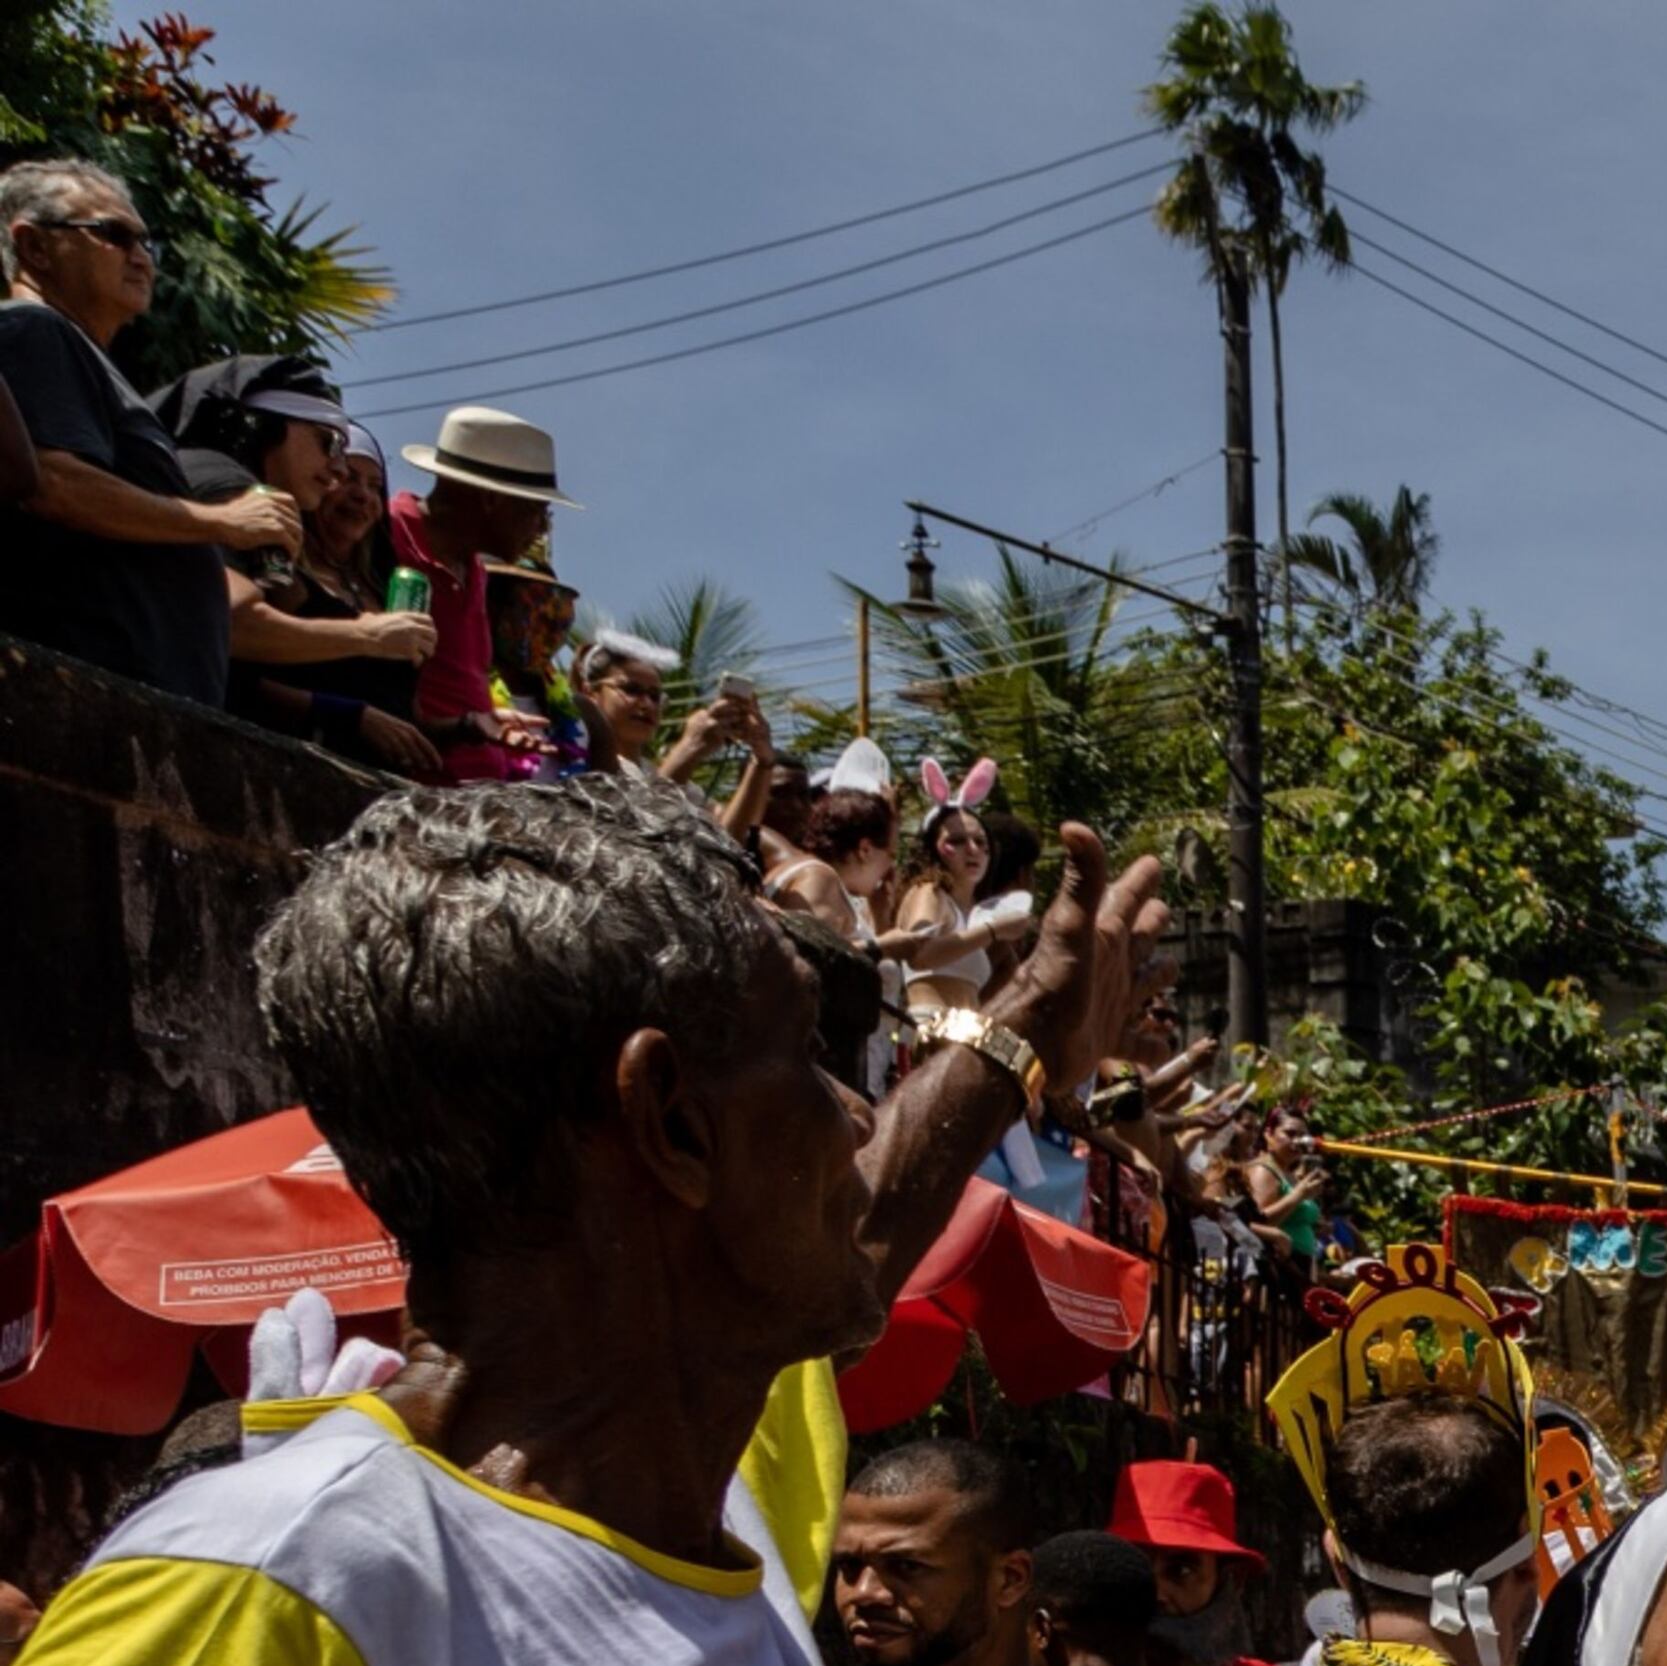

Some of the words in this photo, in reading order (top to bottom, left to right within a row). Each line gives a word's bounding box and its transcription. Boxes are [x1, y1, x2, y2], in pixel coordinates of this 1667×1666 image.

[174, 1267, 214, 1282] BEBA
[216, 1265, 250, 1280] COM
[345, 1249, 390, 1265] VENDA
[189, 1280, 267, 1298] PROIBIDOS
[270, 1276, 306, 1292] PARA
[309, 1267, 374, 1286] MENORES
[377, 1263, 394, 1276] DE
